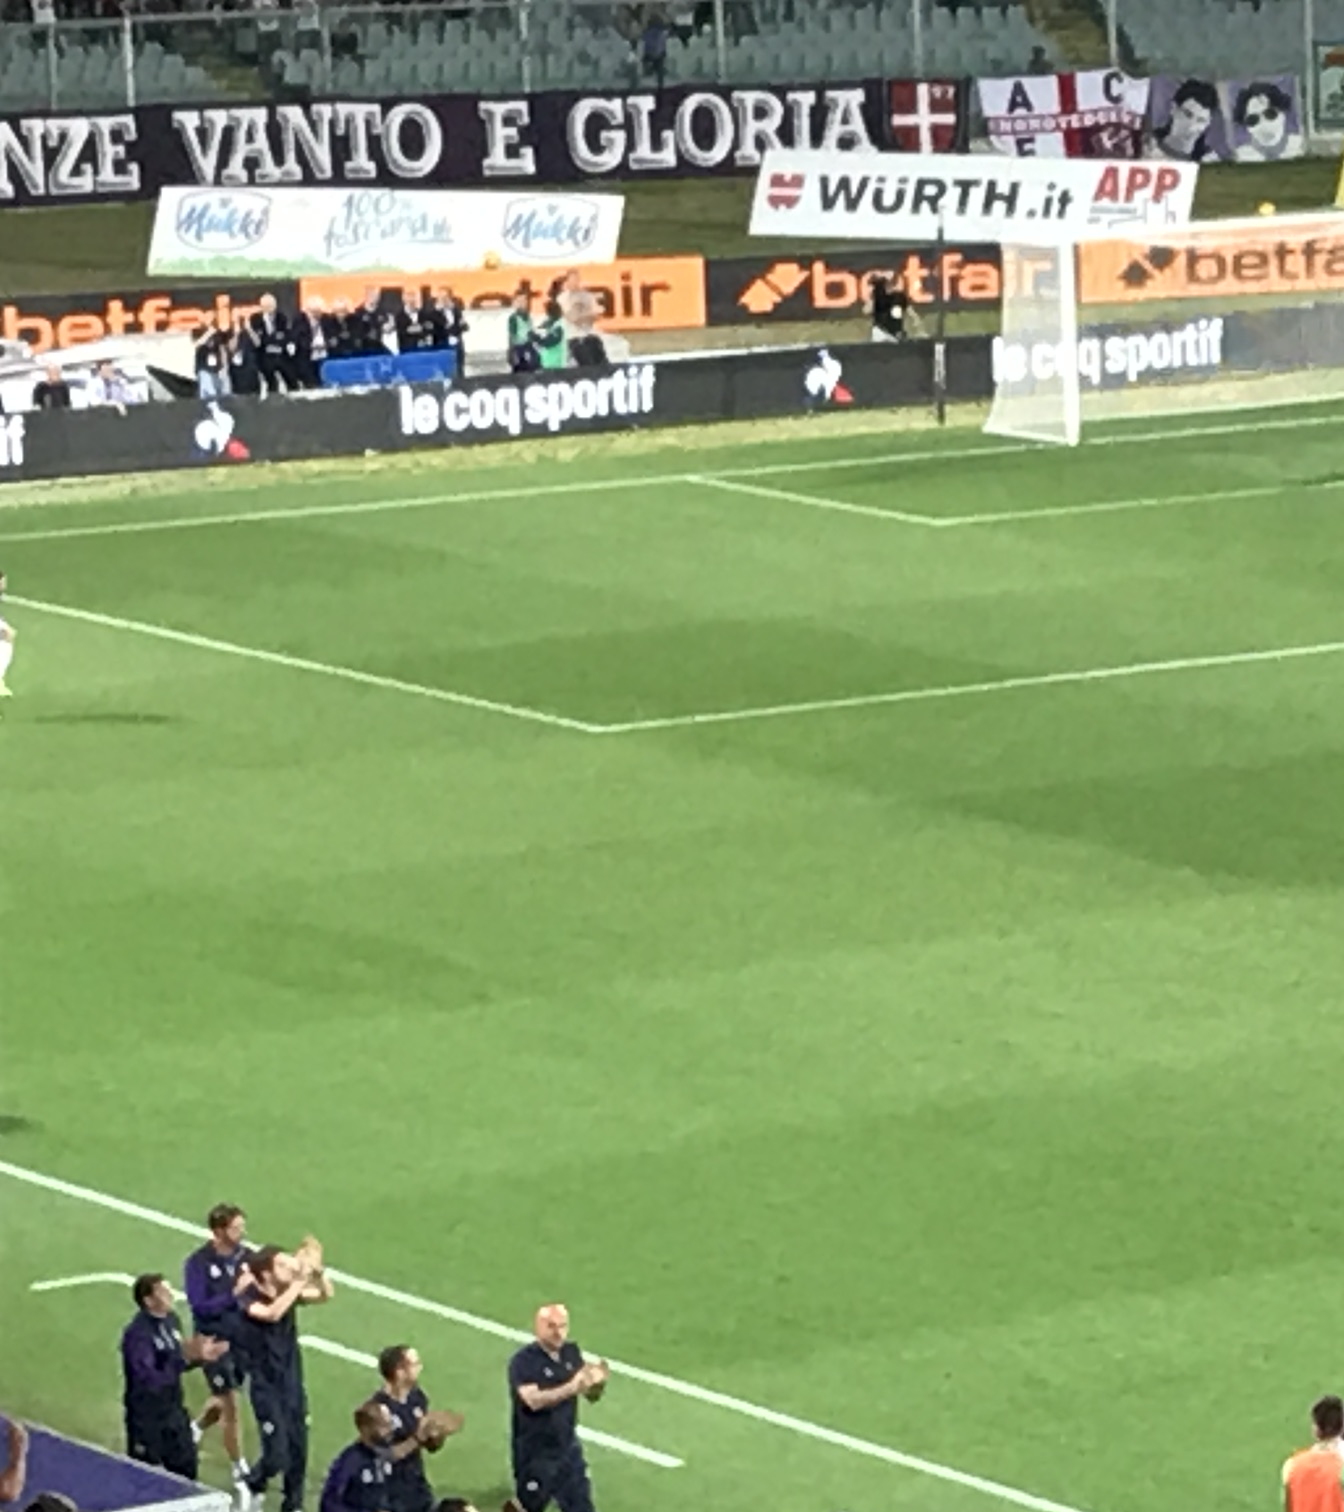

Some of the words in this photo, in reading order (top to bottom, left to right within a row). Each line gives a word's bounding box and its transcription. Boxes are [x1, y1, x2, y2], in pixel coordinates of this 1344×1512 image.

[1008, 79, 1034, 114] A
[1102, 71, 1125, 105] C
[172, 102, 443, 186] VANTO
[478, 100, 537, 176] E
[565, 88, 879, 173] GLORIA
[1091, 165, 1182, 204] APP
[1105, 317, 1223, 381] sportif
[401, 386, 438, 435] le
[443, 387, 520, 436] coq
[524, 364, 656, 432] sportif
